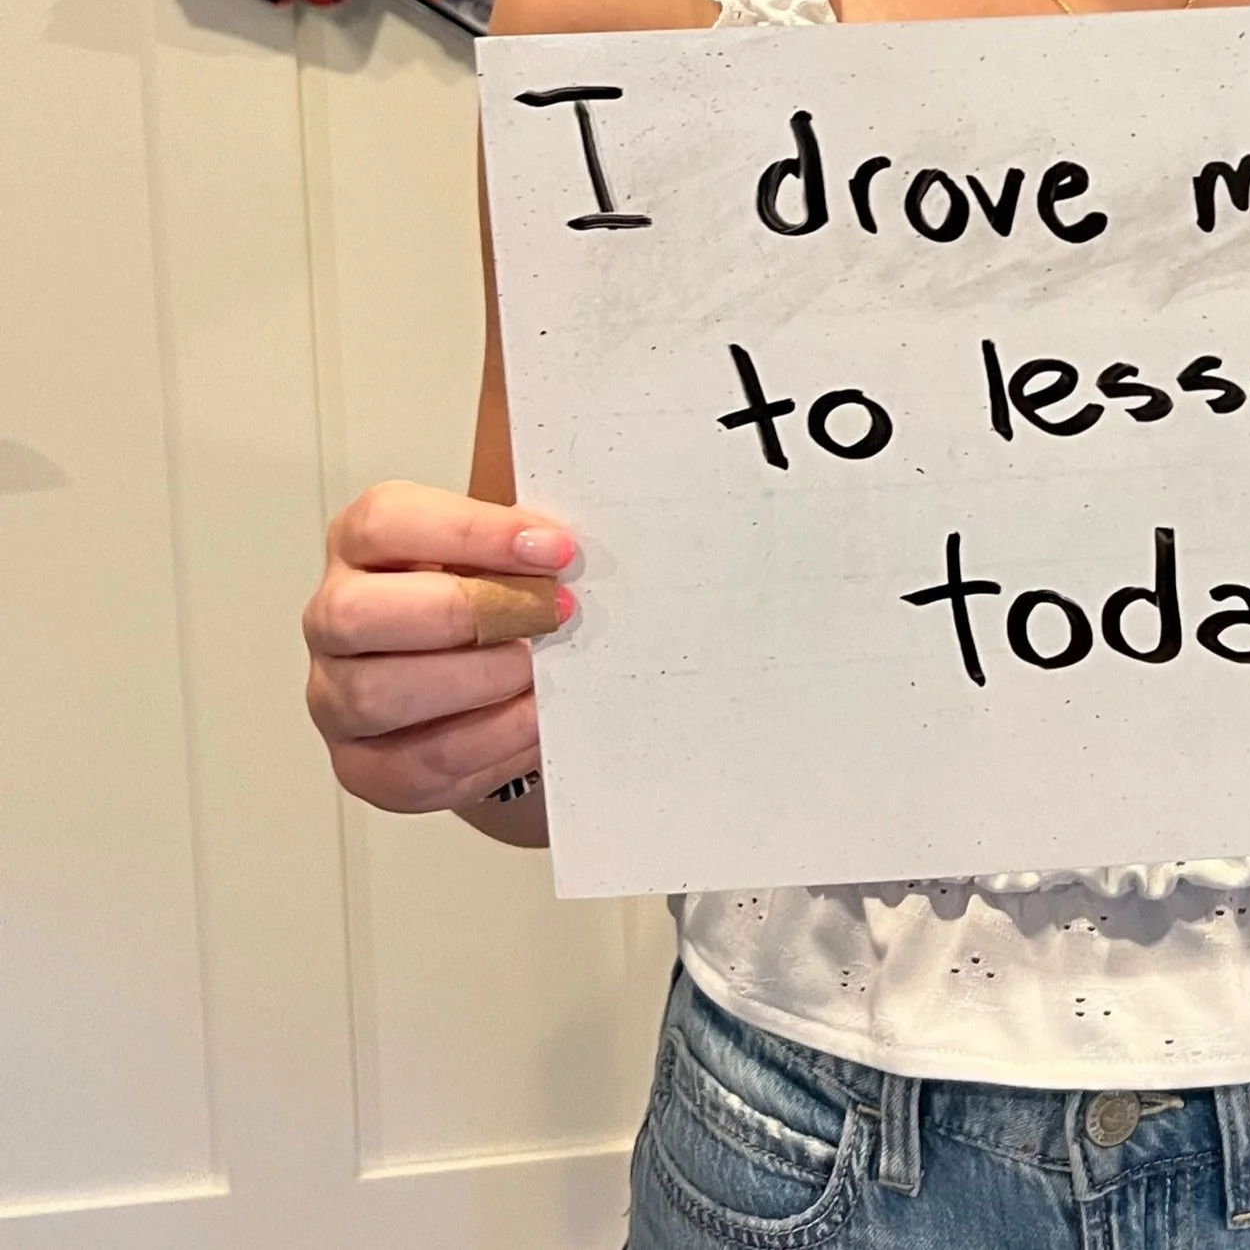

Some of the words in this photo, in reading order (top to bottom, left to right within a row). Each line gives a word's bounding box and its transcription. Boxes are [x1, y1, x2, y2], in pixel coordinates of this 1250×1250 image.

[514, 86, 652, 231] I
[756, 110, 1108, 244] drove
[716, 343, 893, 471] to
